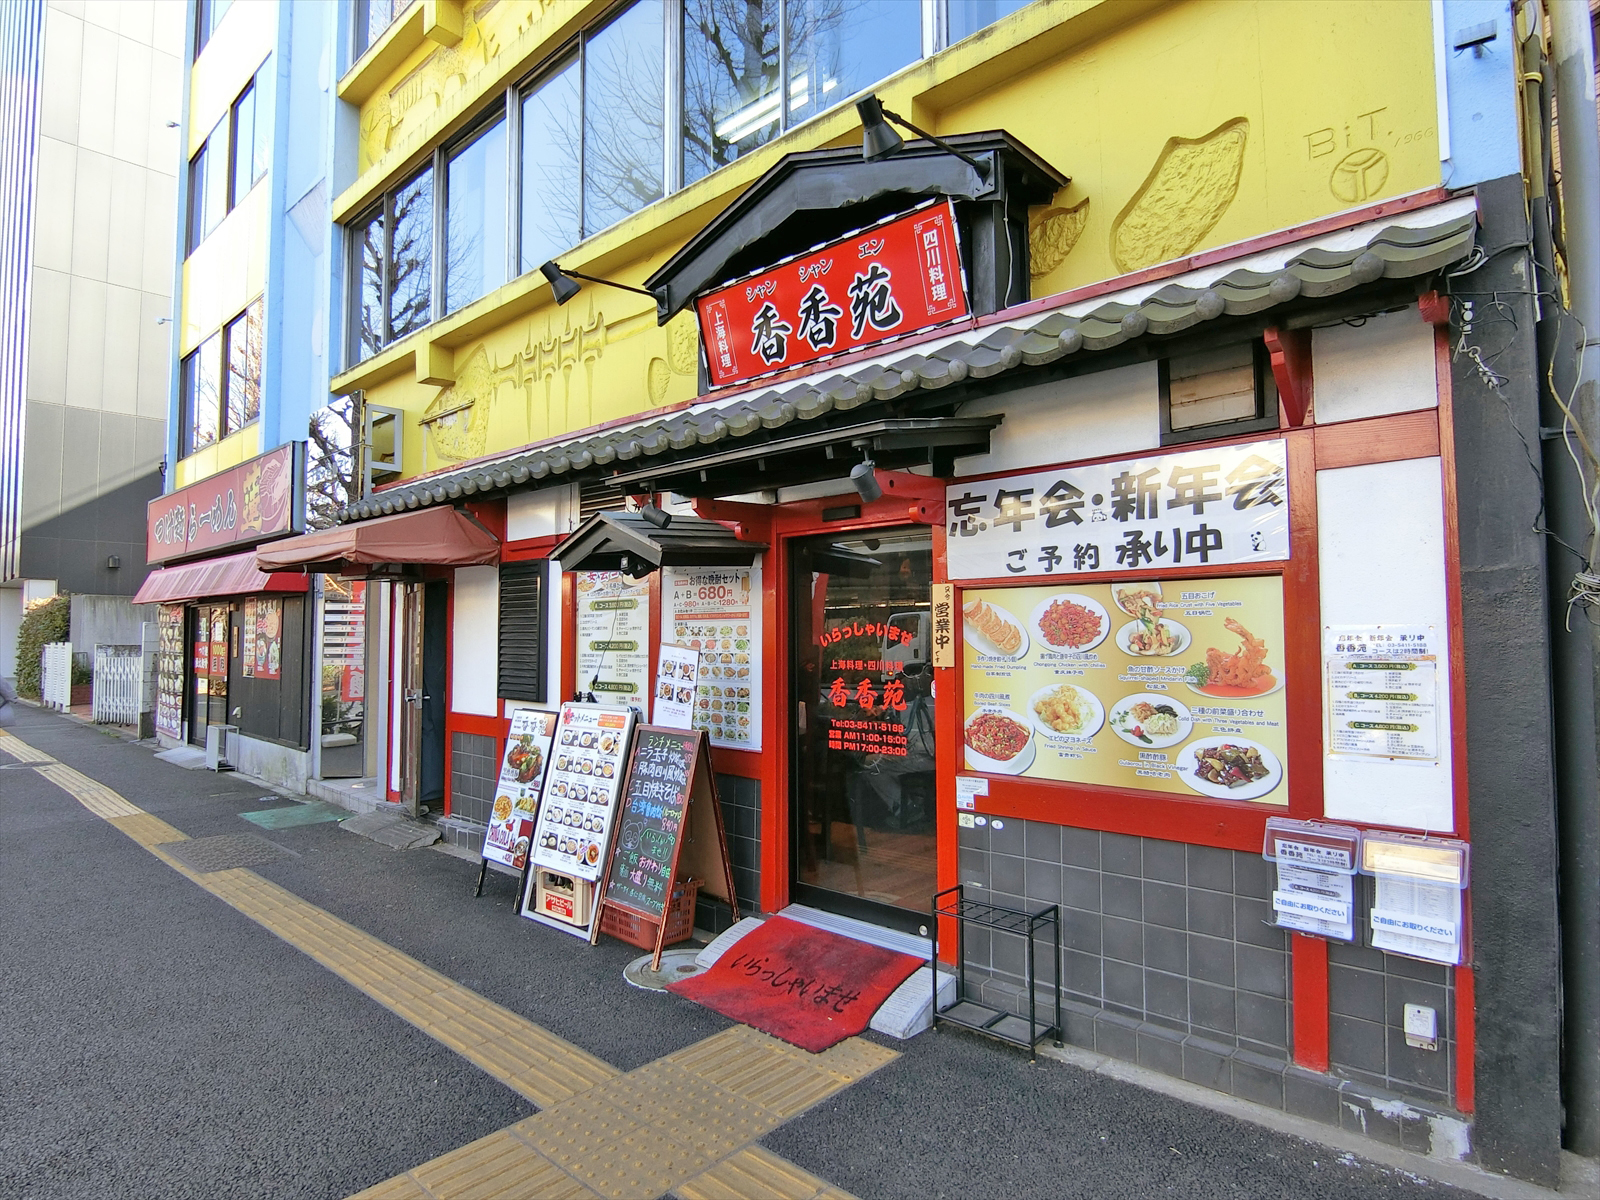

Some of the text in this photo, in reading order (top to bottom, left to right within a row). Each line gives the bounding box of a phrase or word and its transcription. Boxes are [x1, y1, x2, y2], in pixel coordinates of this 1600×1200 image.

[746, 239, 885, 302] シャン シャン エン
[922, 229, 948, 302] 四川料理
[751, 262, 902, 366] 香香苑
[713, 312, 731, 368] 上海料理
[1181, 592, 1215, 600] 五目おこげ
[820, 622, 913, 647] いらっしゃいませ
[935, 602, 950, 650] 営業中
[830, 660, 904, 671] 上海料理・四川料理
[828, 677, 907, 711] 香香苑
[1191, 707, 1264, 717] 三種の前菜盛り合わせ
[546, 894, 573, 910] アサヒビール
[1275, 898, 1345, 917] ご自由にお取りください
[1373, 915, 1453, 937] ご自由にお取りください
[730, 953, 858, 1013] いらっしゃいませ
